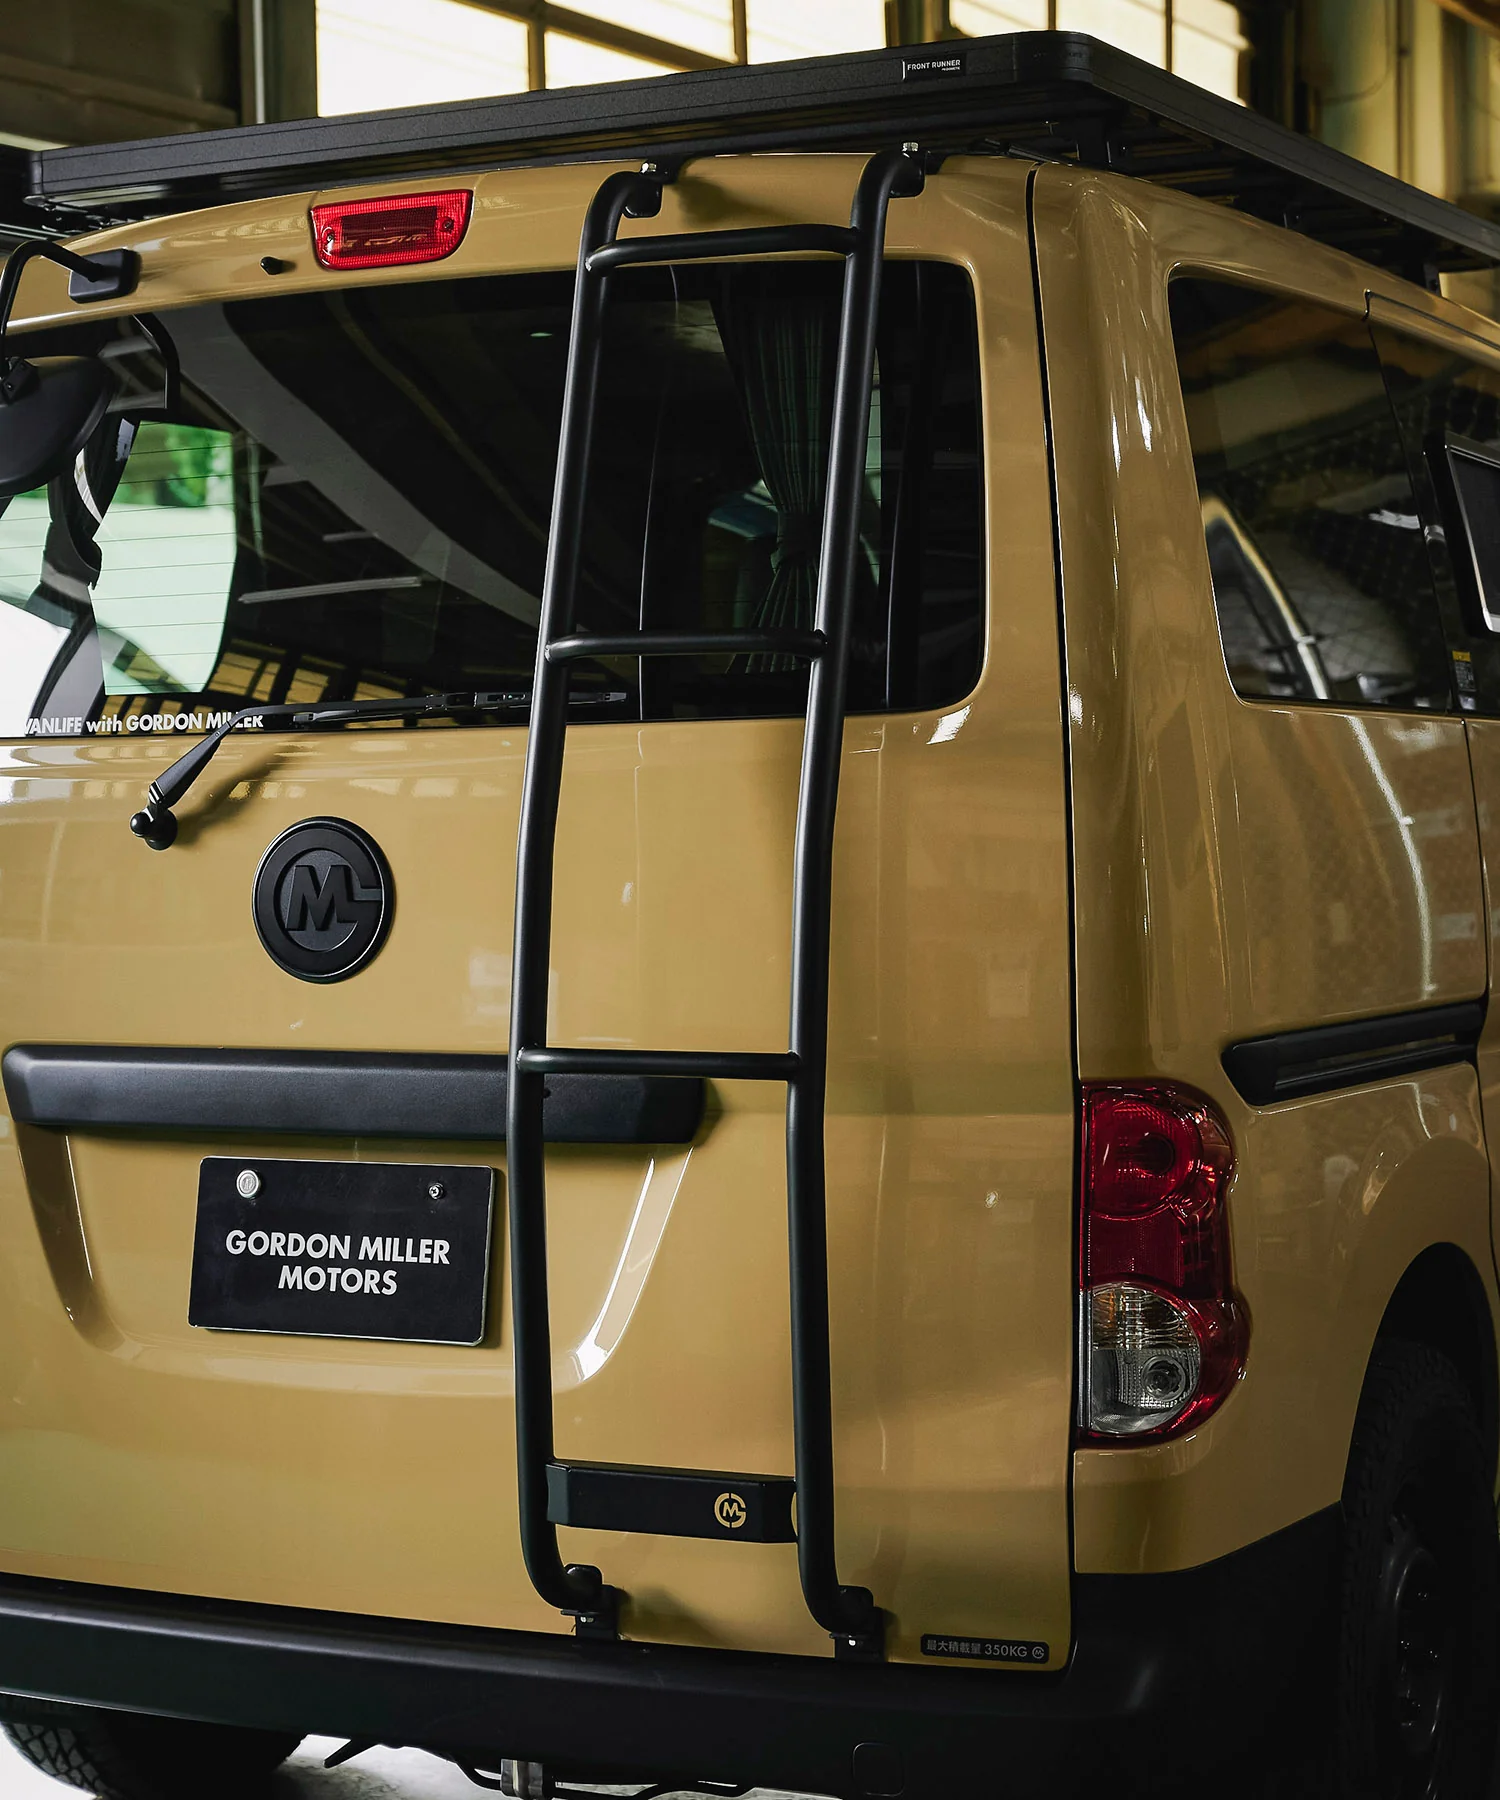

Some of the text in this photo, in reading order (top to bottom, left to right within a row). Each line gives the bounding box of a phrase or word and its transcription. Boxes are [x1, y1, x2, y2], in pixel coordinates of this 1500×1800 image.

[907, 59, 961, 71] FRONT RUNNER
[24, 717, 82, 734] VANLIFE
[86, 714, 122, 732] with
[126, 713, 202, 731] GORDON
[225, 1229, 451, 1265] GORDON MILLER
[278, 1265, 398, 1296] MOTORS
[926, 1639, 982, 1655] 最大積載量
[984, 1643, 1028, 1658] 350KG
